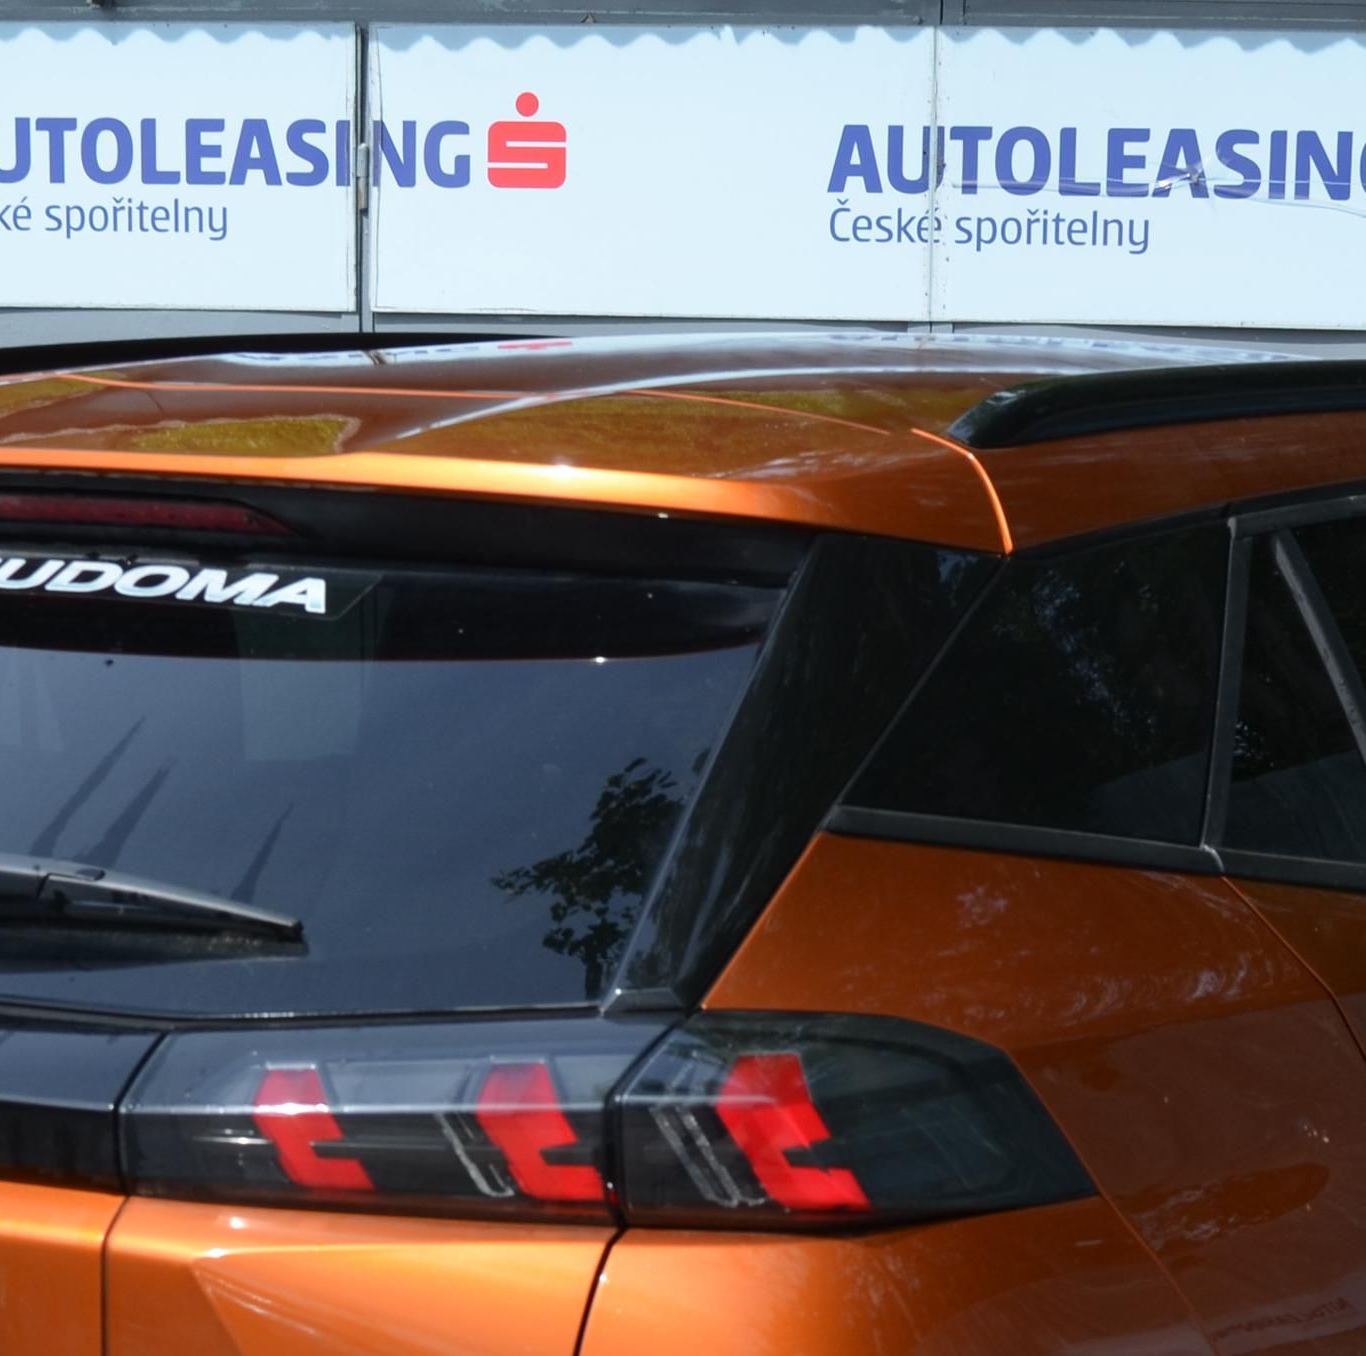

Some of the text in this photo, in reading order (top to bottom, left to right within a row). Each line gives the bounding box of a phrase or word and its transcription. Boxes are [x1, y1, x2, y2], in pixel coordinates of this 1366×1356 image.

[44, 196, 228, 241] spořitelny
[828, 200, 1150, 255] České spořitelny
